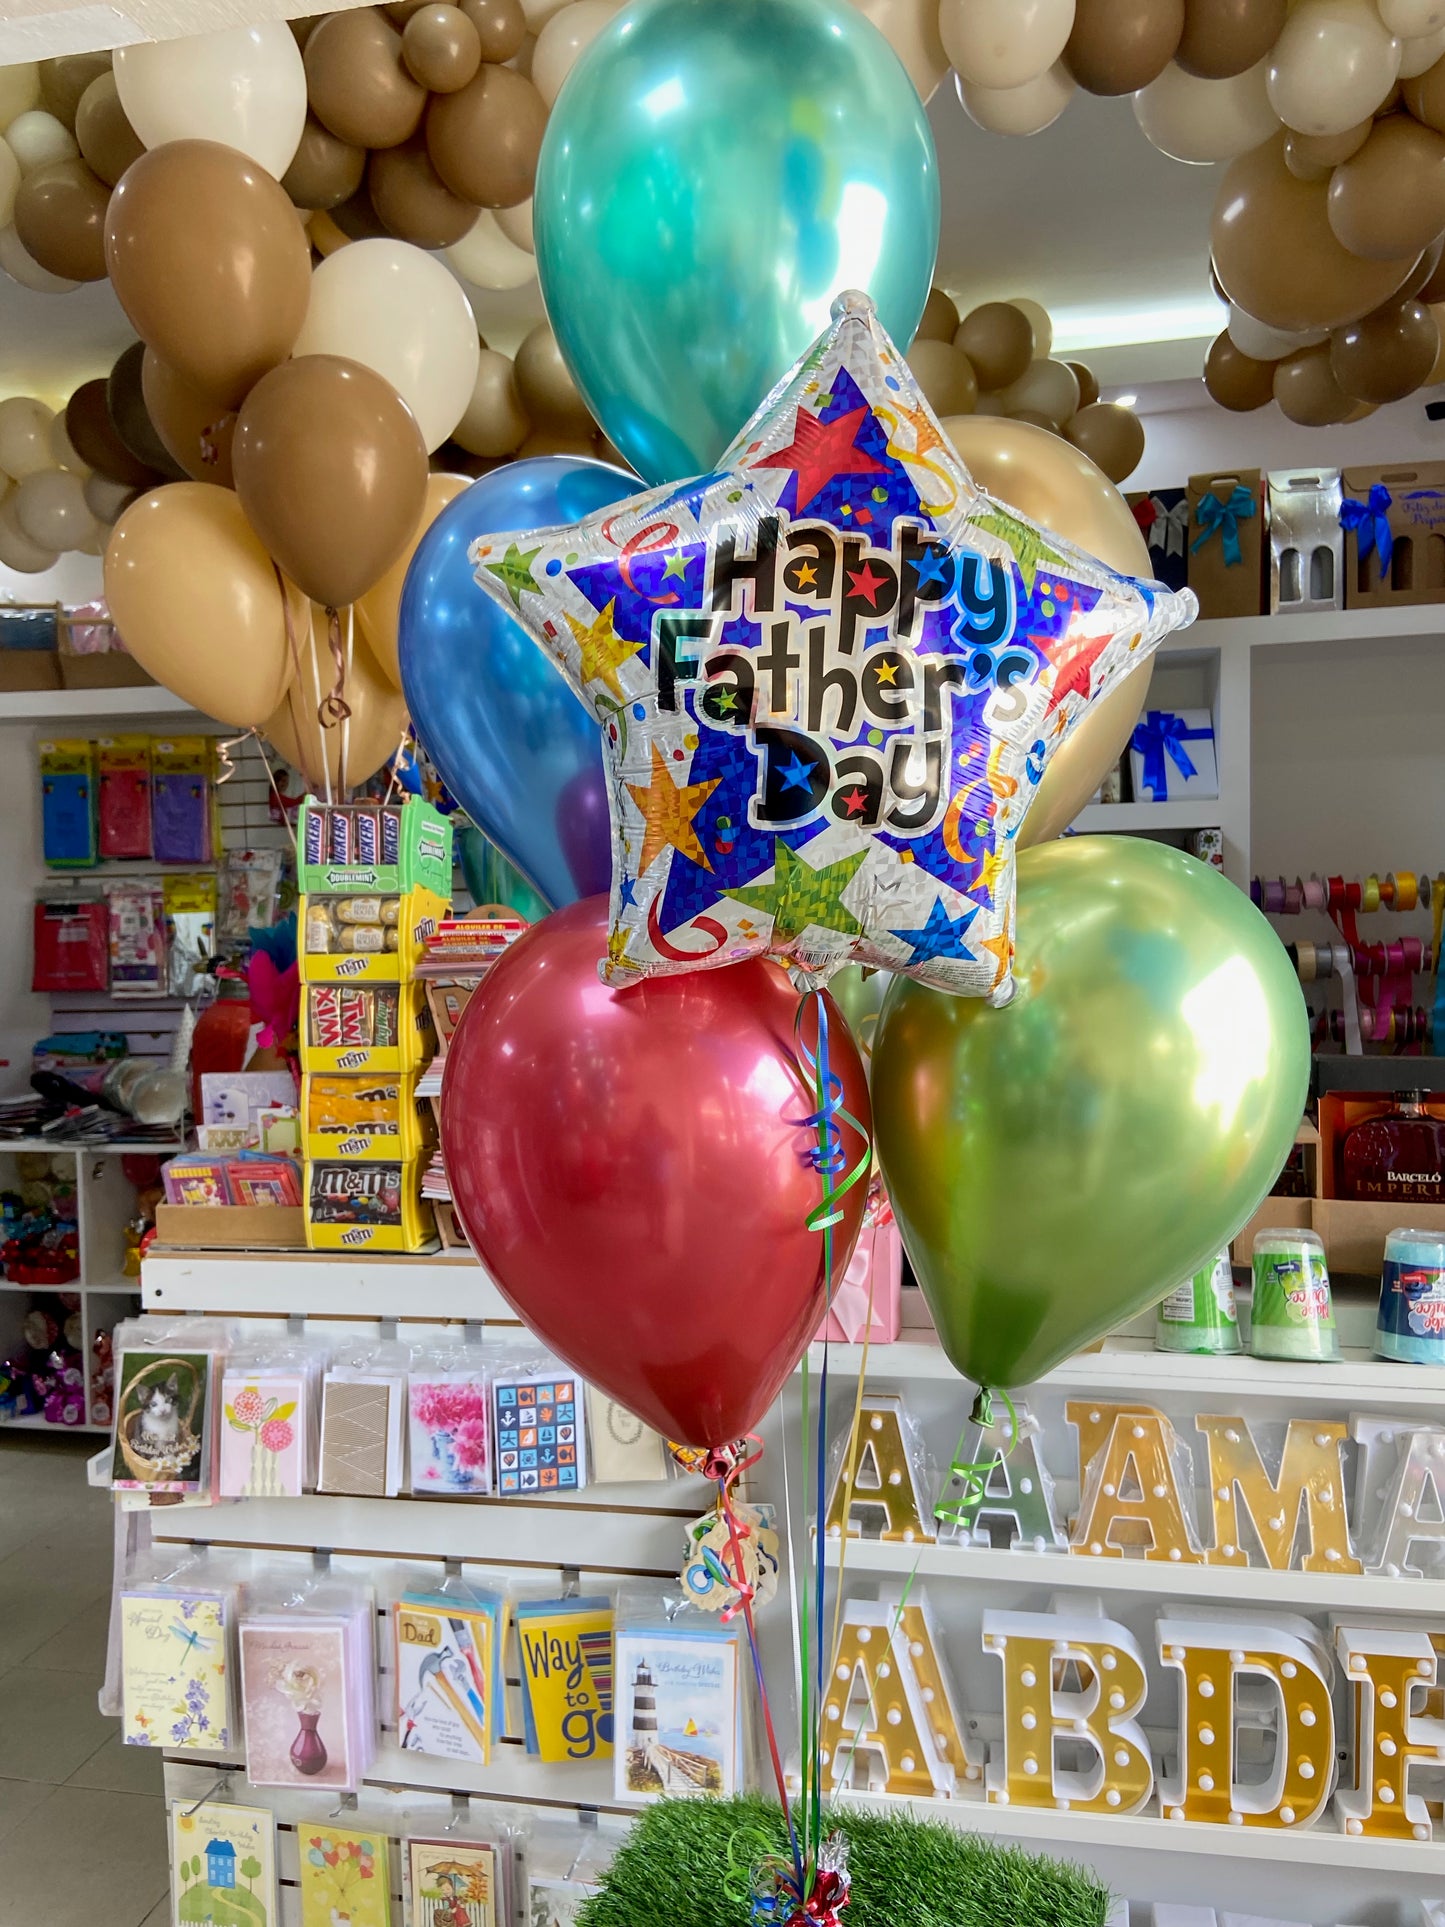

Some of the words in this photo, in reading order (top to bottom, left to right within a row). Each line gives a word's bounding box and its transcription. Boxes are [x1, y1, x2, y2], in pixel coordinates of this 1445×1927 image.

[711, 514, 1016, 655] Happy
[657, 618, 1034, 733] Father's
[755, 727, 943, 829] Day
[308, 813, 321, 865] NICKERS
[333, 815, 347, 865] NICKERS
[359, 816, 375, 865] NICKERS
[384, 814, 398, 865] NICKERS
[330, 873, 373, 882] DOUBLEMINT
[320, 1168, 399, 1196] m&m's
[1356, 1180, 1441, 1196] IMPERI
[1387, 1171, 1441, 1183] BARCELÓ
[1415, 1301, 1445, 1317] ulce
[1424, 1316, 1445, 1334] ube
[403, 1622, 437, 1646] Dad
[524, 1631, 584, 1690] Way
[564, 1692, 590, 1708] to
[982, 1609, 1154, 1815] B
[1156, 1618, 1334, 1828] D
